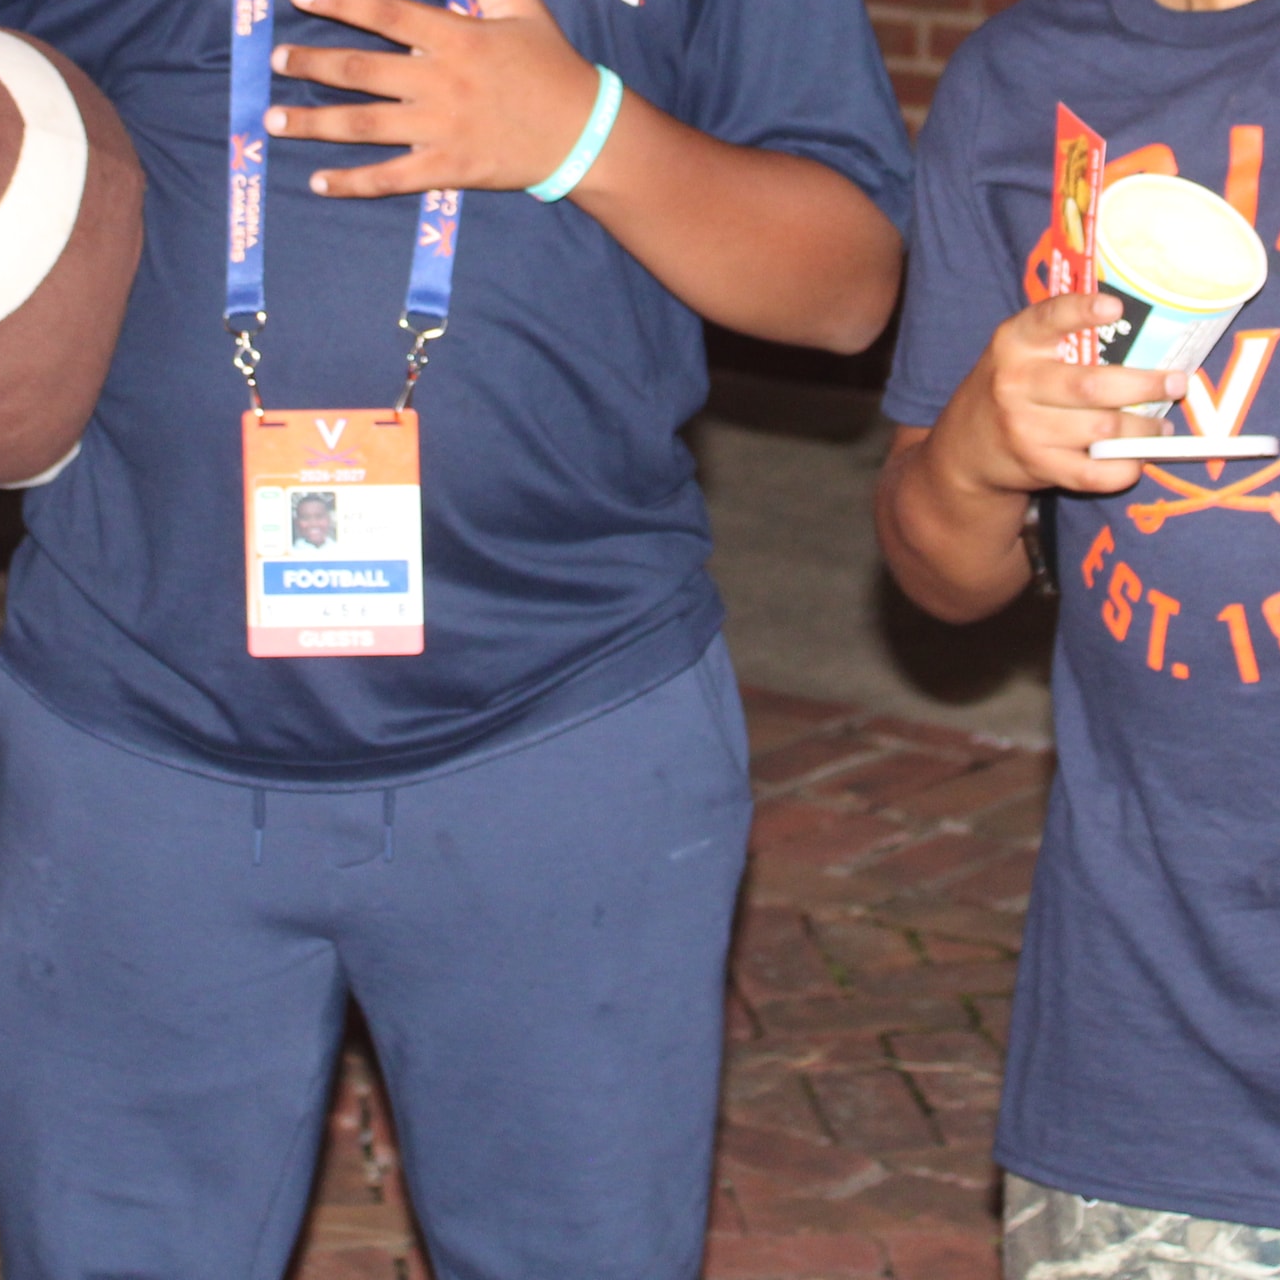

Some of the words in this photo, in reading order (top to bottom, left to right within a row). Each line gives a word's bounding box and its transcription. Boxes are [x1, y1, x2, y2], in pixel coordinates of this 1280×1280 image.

[229, 173, 247, 263] CAVALIERS
[246, 174, 261, 249] VIRGINIA
[283, 569, 391, 589] FOOTBALL
[1081, 524, 1190, 680] EST.
[298, 629, 375, 648] GUESTS
